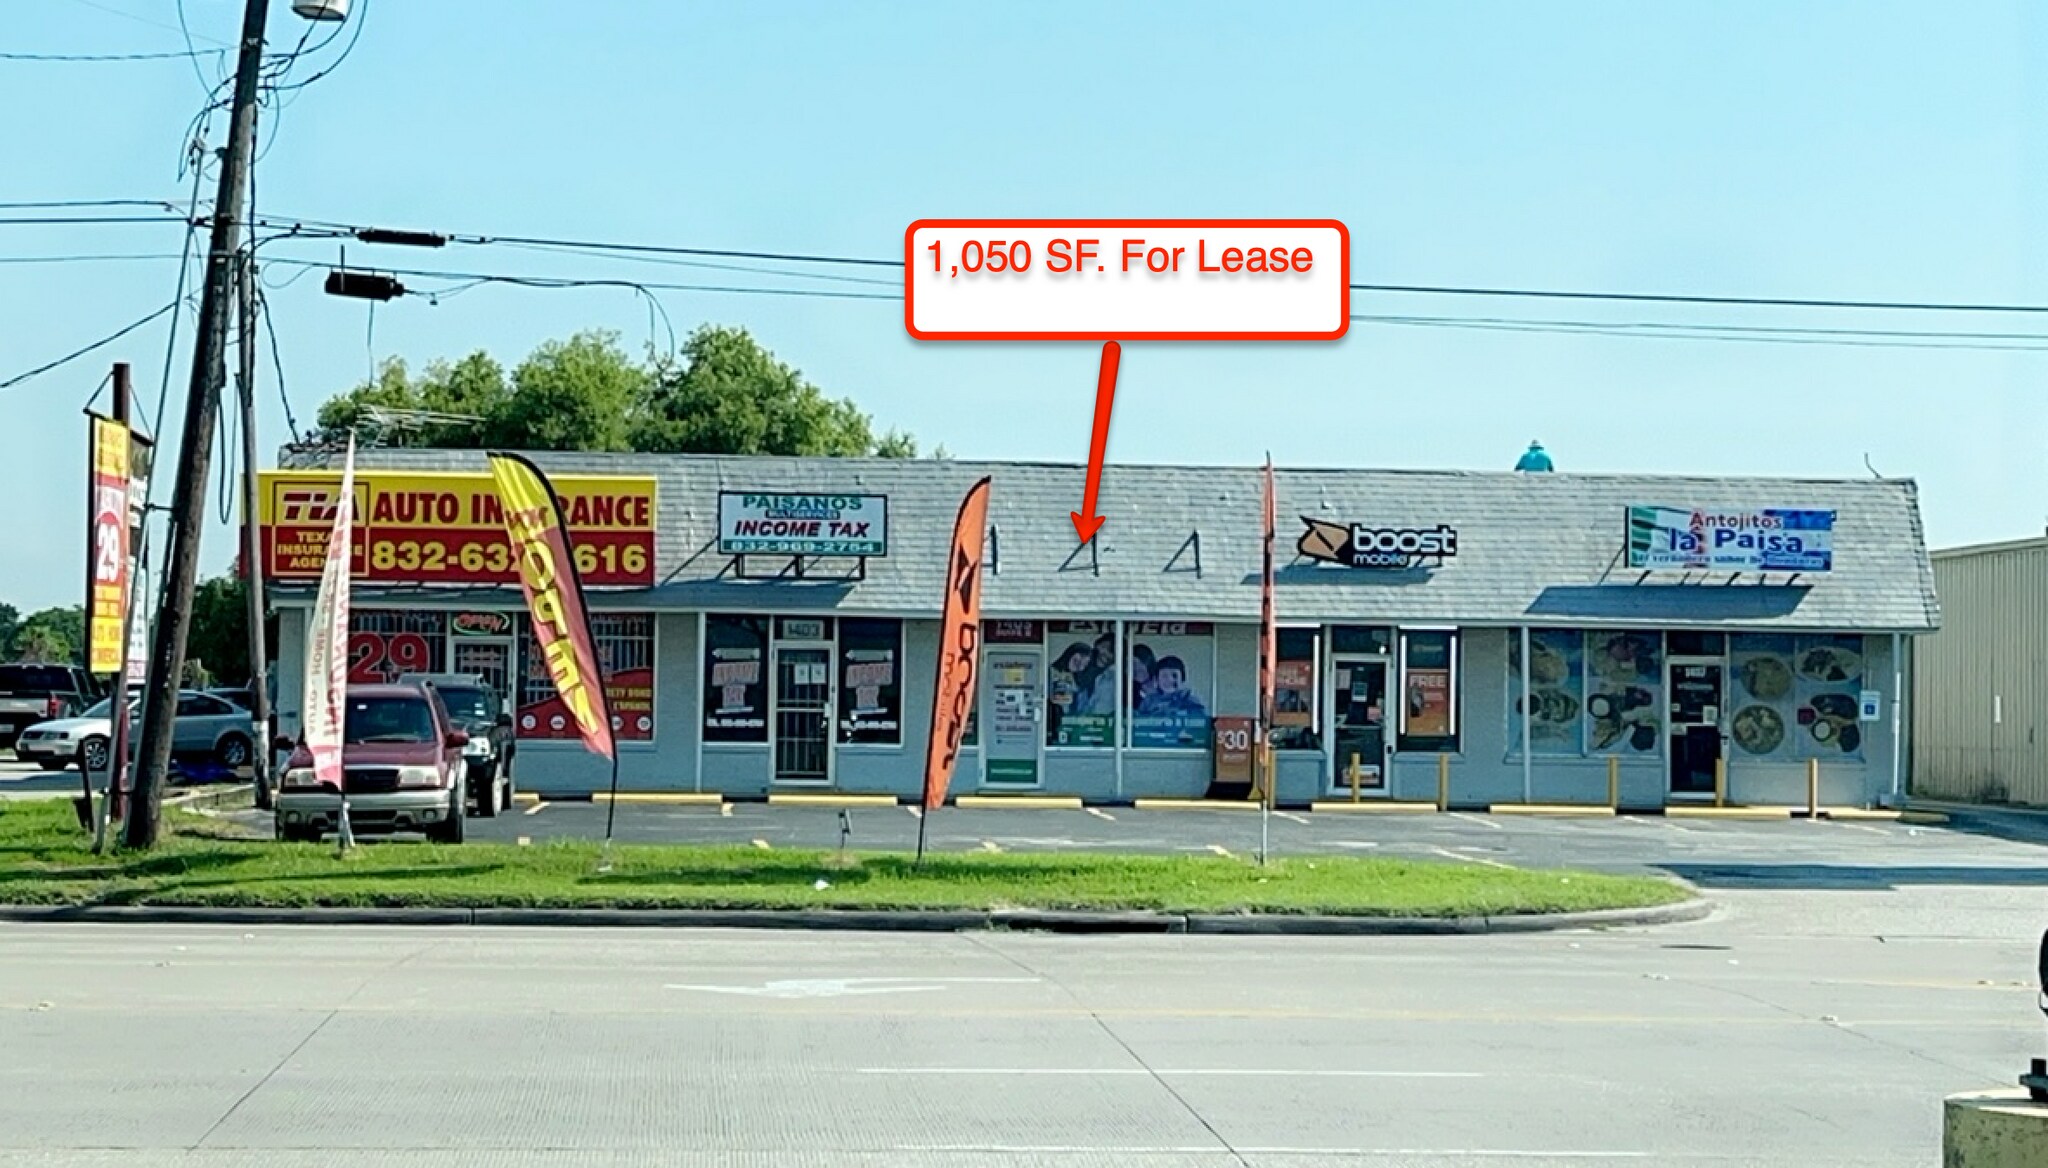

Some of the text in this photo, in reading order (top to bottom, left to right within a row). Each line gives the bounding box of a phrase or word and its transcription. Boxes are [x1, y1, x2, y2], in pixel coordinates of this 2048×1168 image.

[372, 491, 460, 523] AUTO
[471, 492, 650, 527] INRANCE
[742, 495, 863, 510] PAISANOS
[734, 520, 871, 538] INCOME TAX
[1690, 512, 1784, 531] Antojitos
[296, 531, 337, 544] TEXA
[1352, 525, 1456, 554] boost
[1669, 528, 1803, 553] la Paisa
[97, 523, 120, 583] 29
[276, 543, 364, 557] INSURAE
[1353, 553, 1408, 566] mobile
[1409, 674, 1447, 688] FREE
